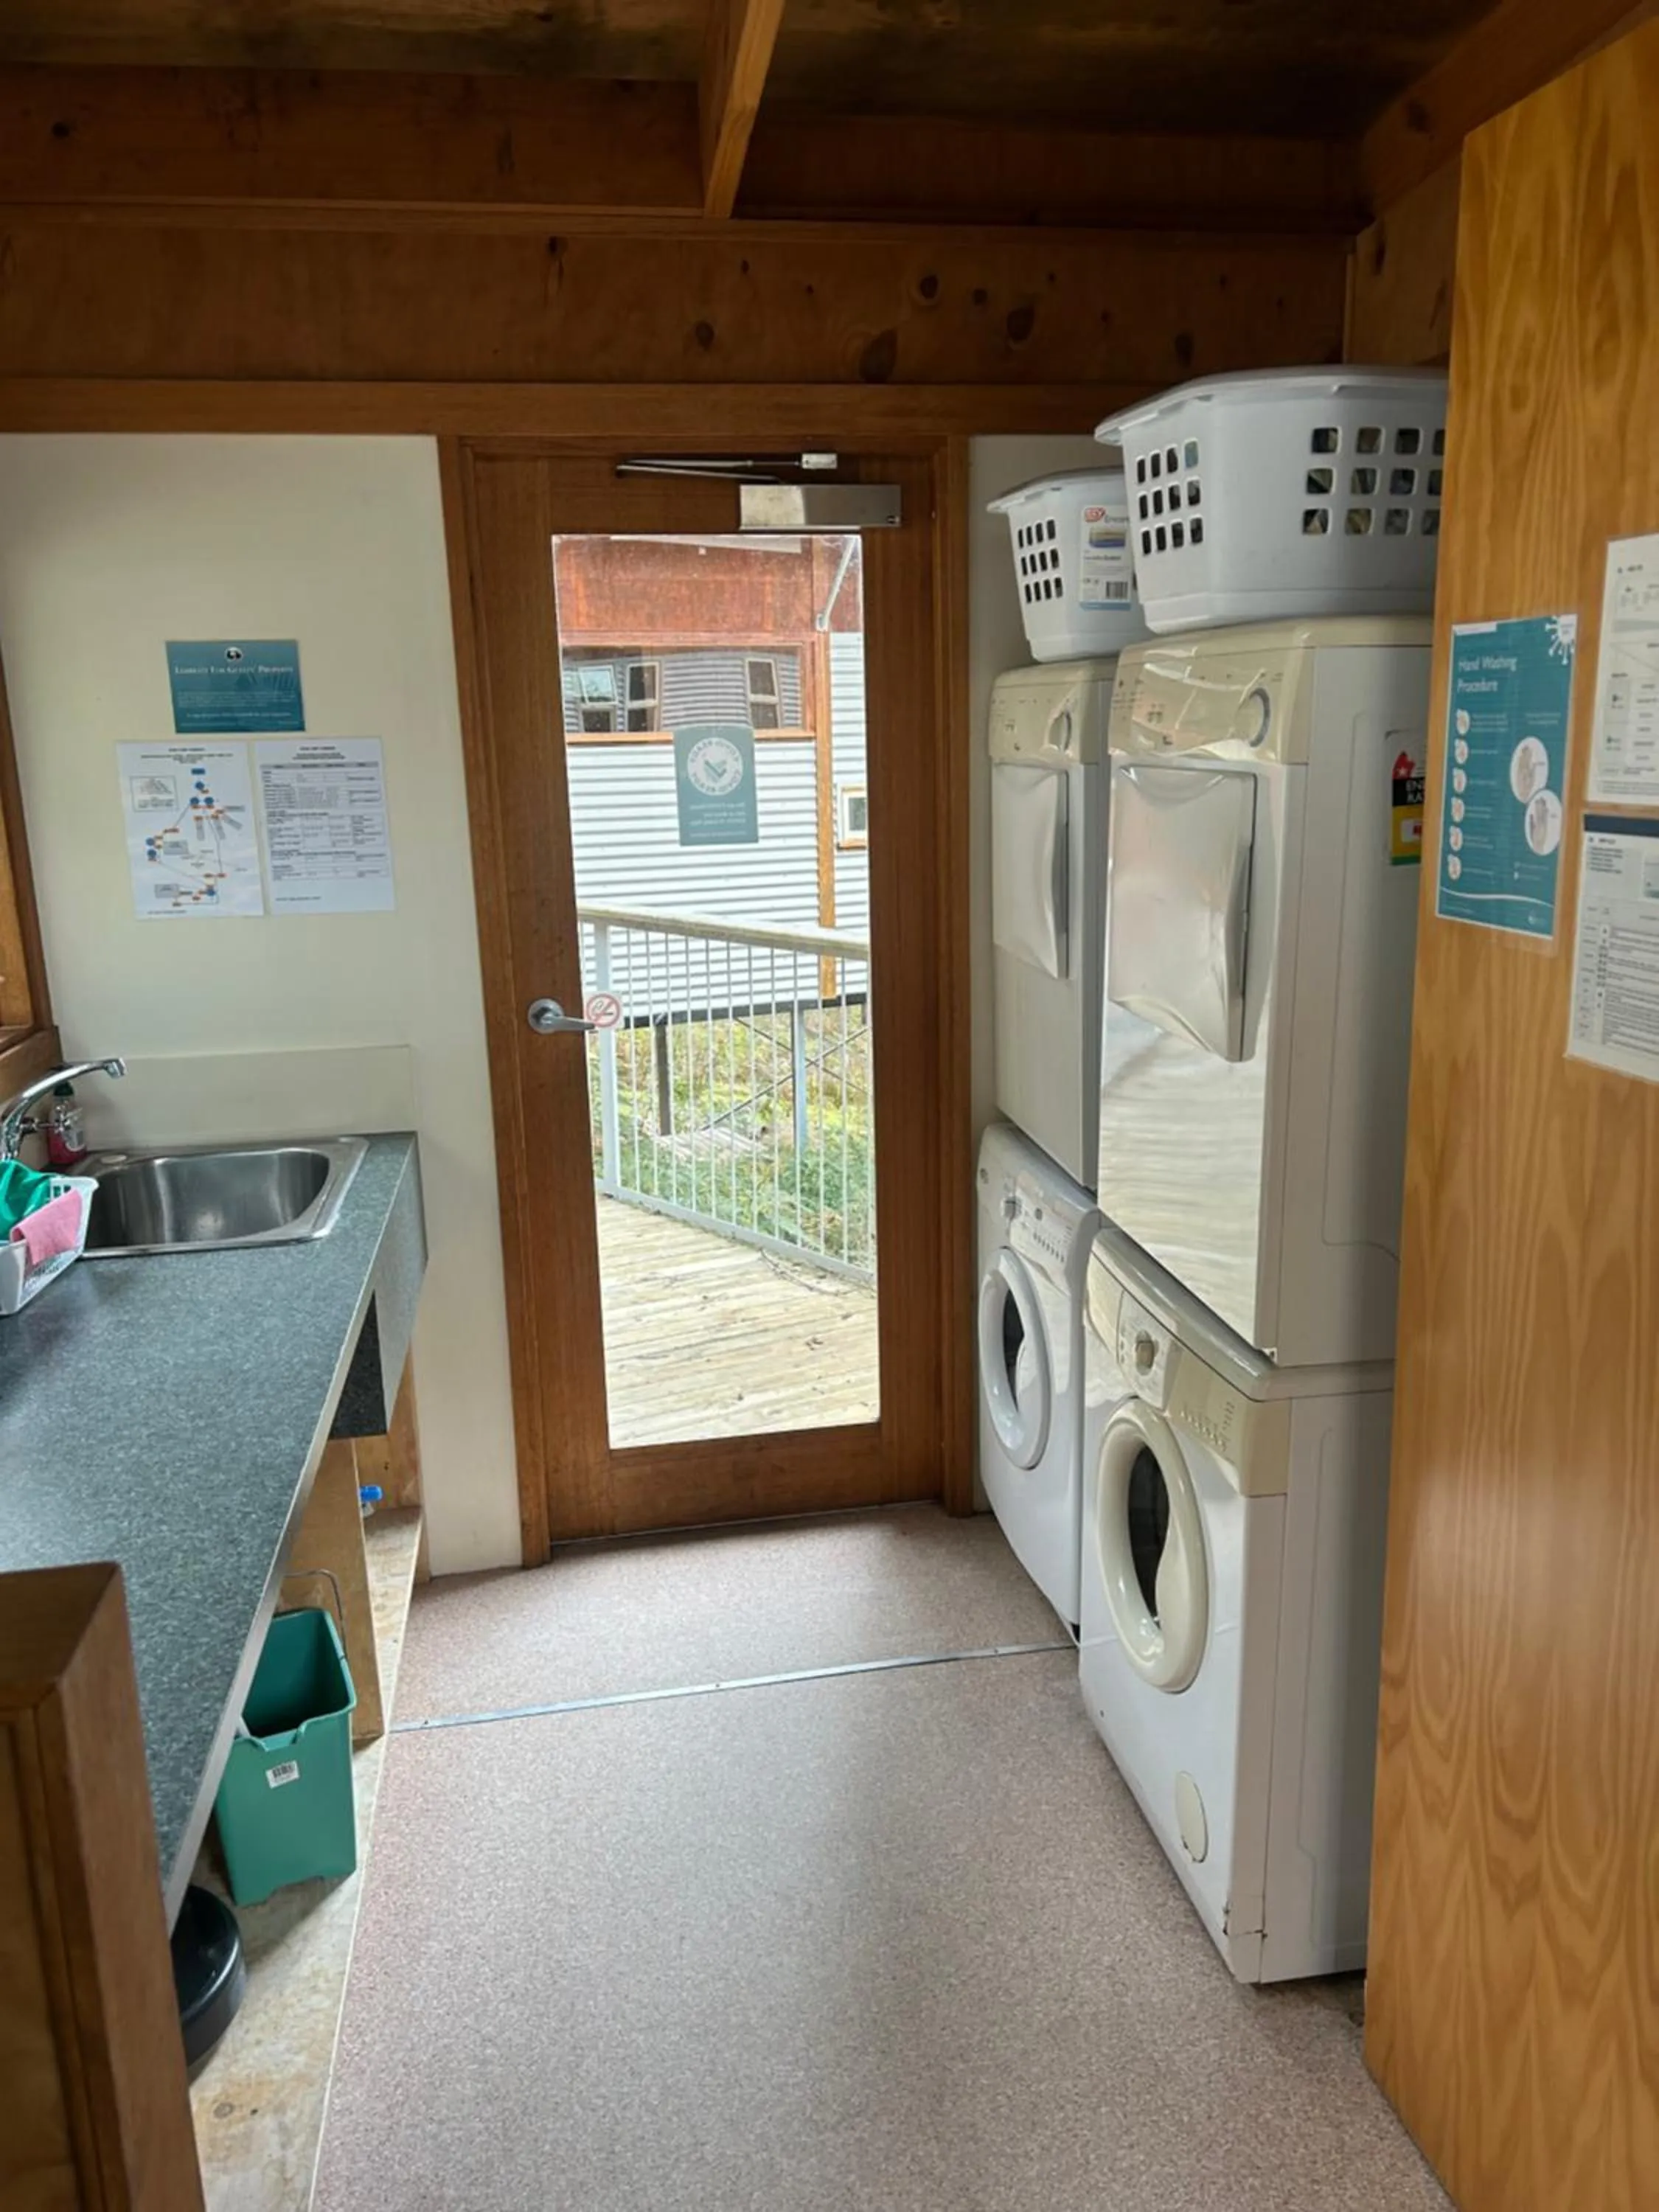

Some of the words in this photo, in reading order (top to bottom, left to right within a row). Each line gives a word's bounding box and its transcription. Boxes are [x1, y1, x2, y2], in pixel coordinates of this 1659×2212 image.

[1459, 657, 1479, 672] Hand
[1482, 656, 1518, 672] Washing
[1457, 678, 1498, 692] Procedure
